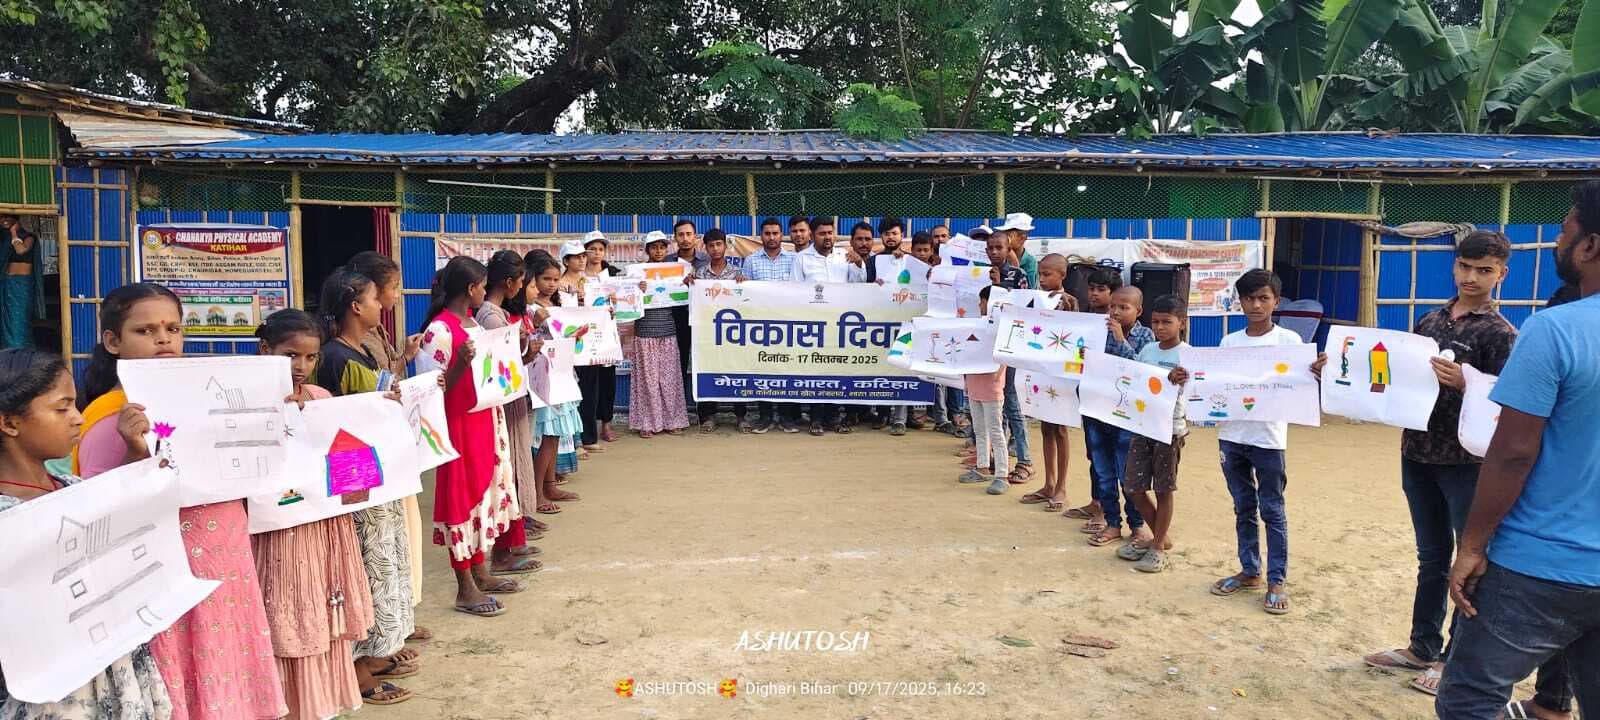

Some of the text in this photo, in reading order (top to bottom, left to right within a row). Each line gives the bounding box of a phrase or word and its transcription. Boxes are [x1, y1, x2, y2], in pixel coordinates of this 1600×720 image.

[175, 231, 282, 243] CHANAKYA PHYSICAL ACADEMY
[210, 243, 247, 251] KATIHAR
[713, 308, 902, 349] विकास दिव
[797, 354, 808, 364] 17
[811, 351, 849, 364] सितम्बर
[851, 355, 878, 364] 2025
[714, 375, 920, 390] मेरा युवा भारत, कटिहार
